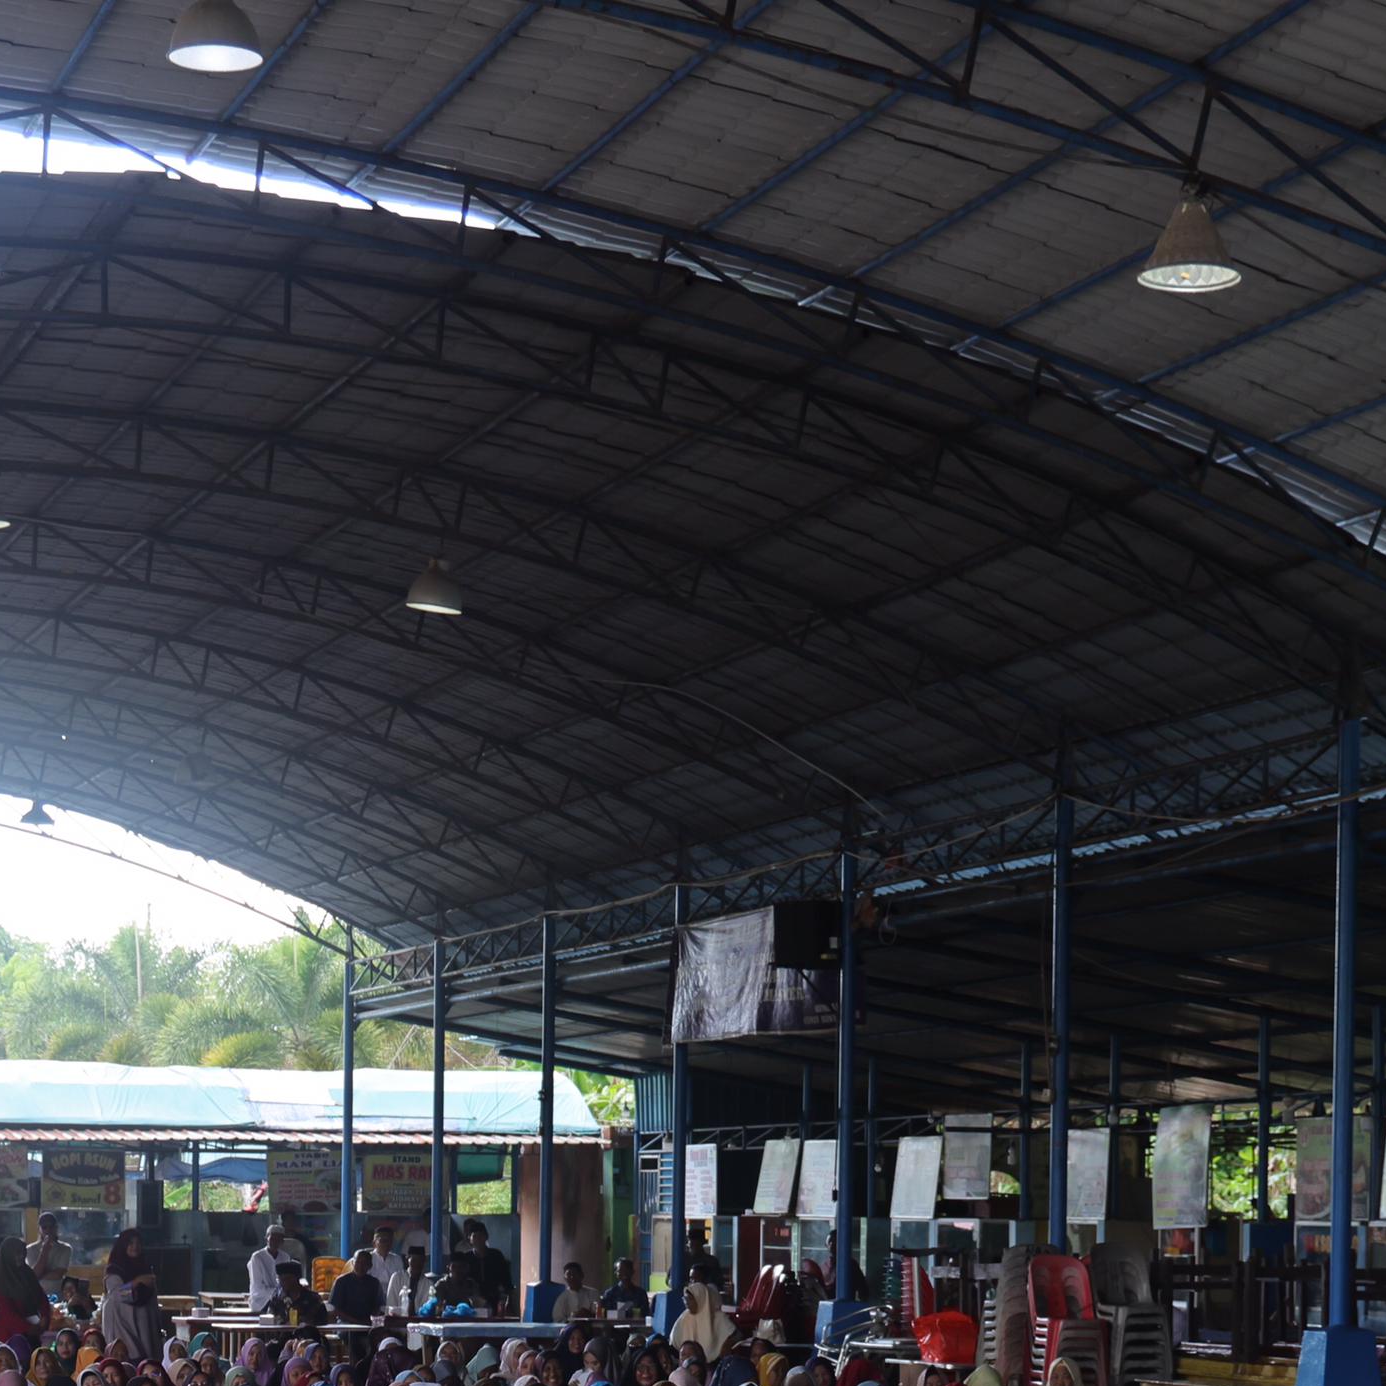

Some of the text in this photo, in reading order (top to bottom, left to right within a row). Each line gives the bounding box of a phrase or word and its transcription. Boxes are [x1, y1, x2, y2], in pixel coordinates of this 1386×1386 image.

[393, 1155, 421, 1163] STAND
[372, 1164, 406, 1181] MAS
[104, 1183, 120, 1205] 8
